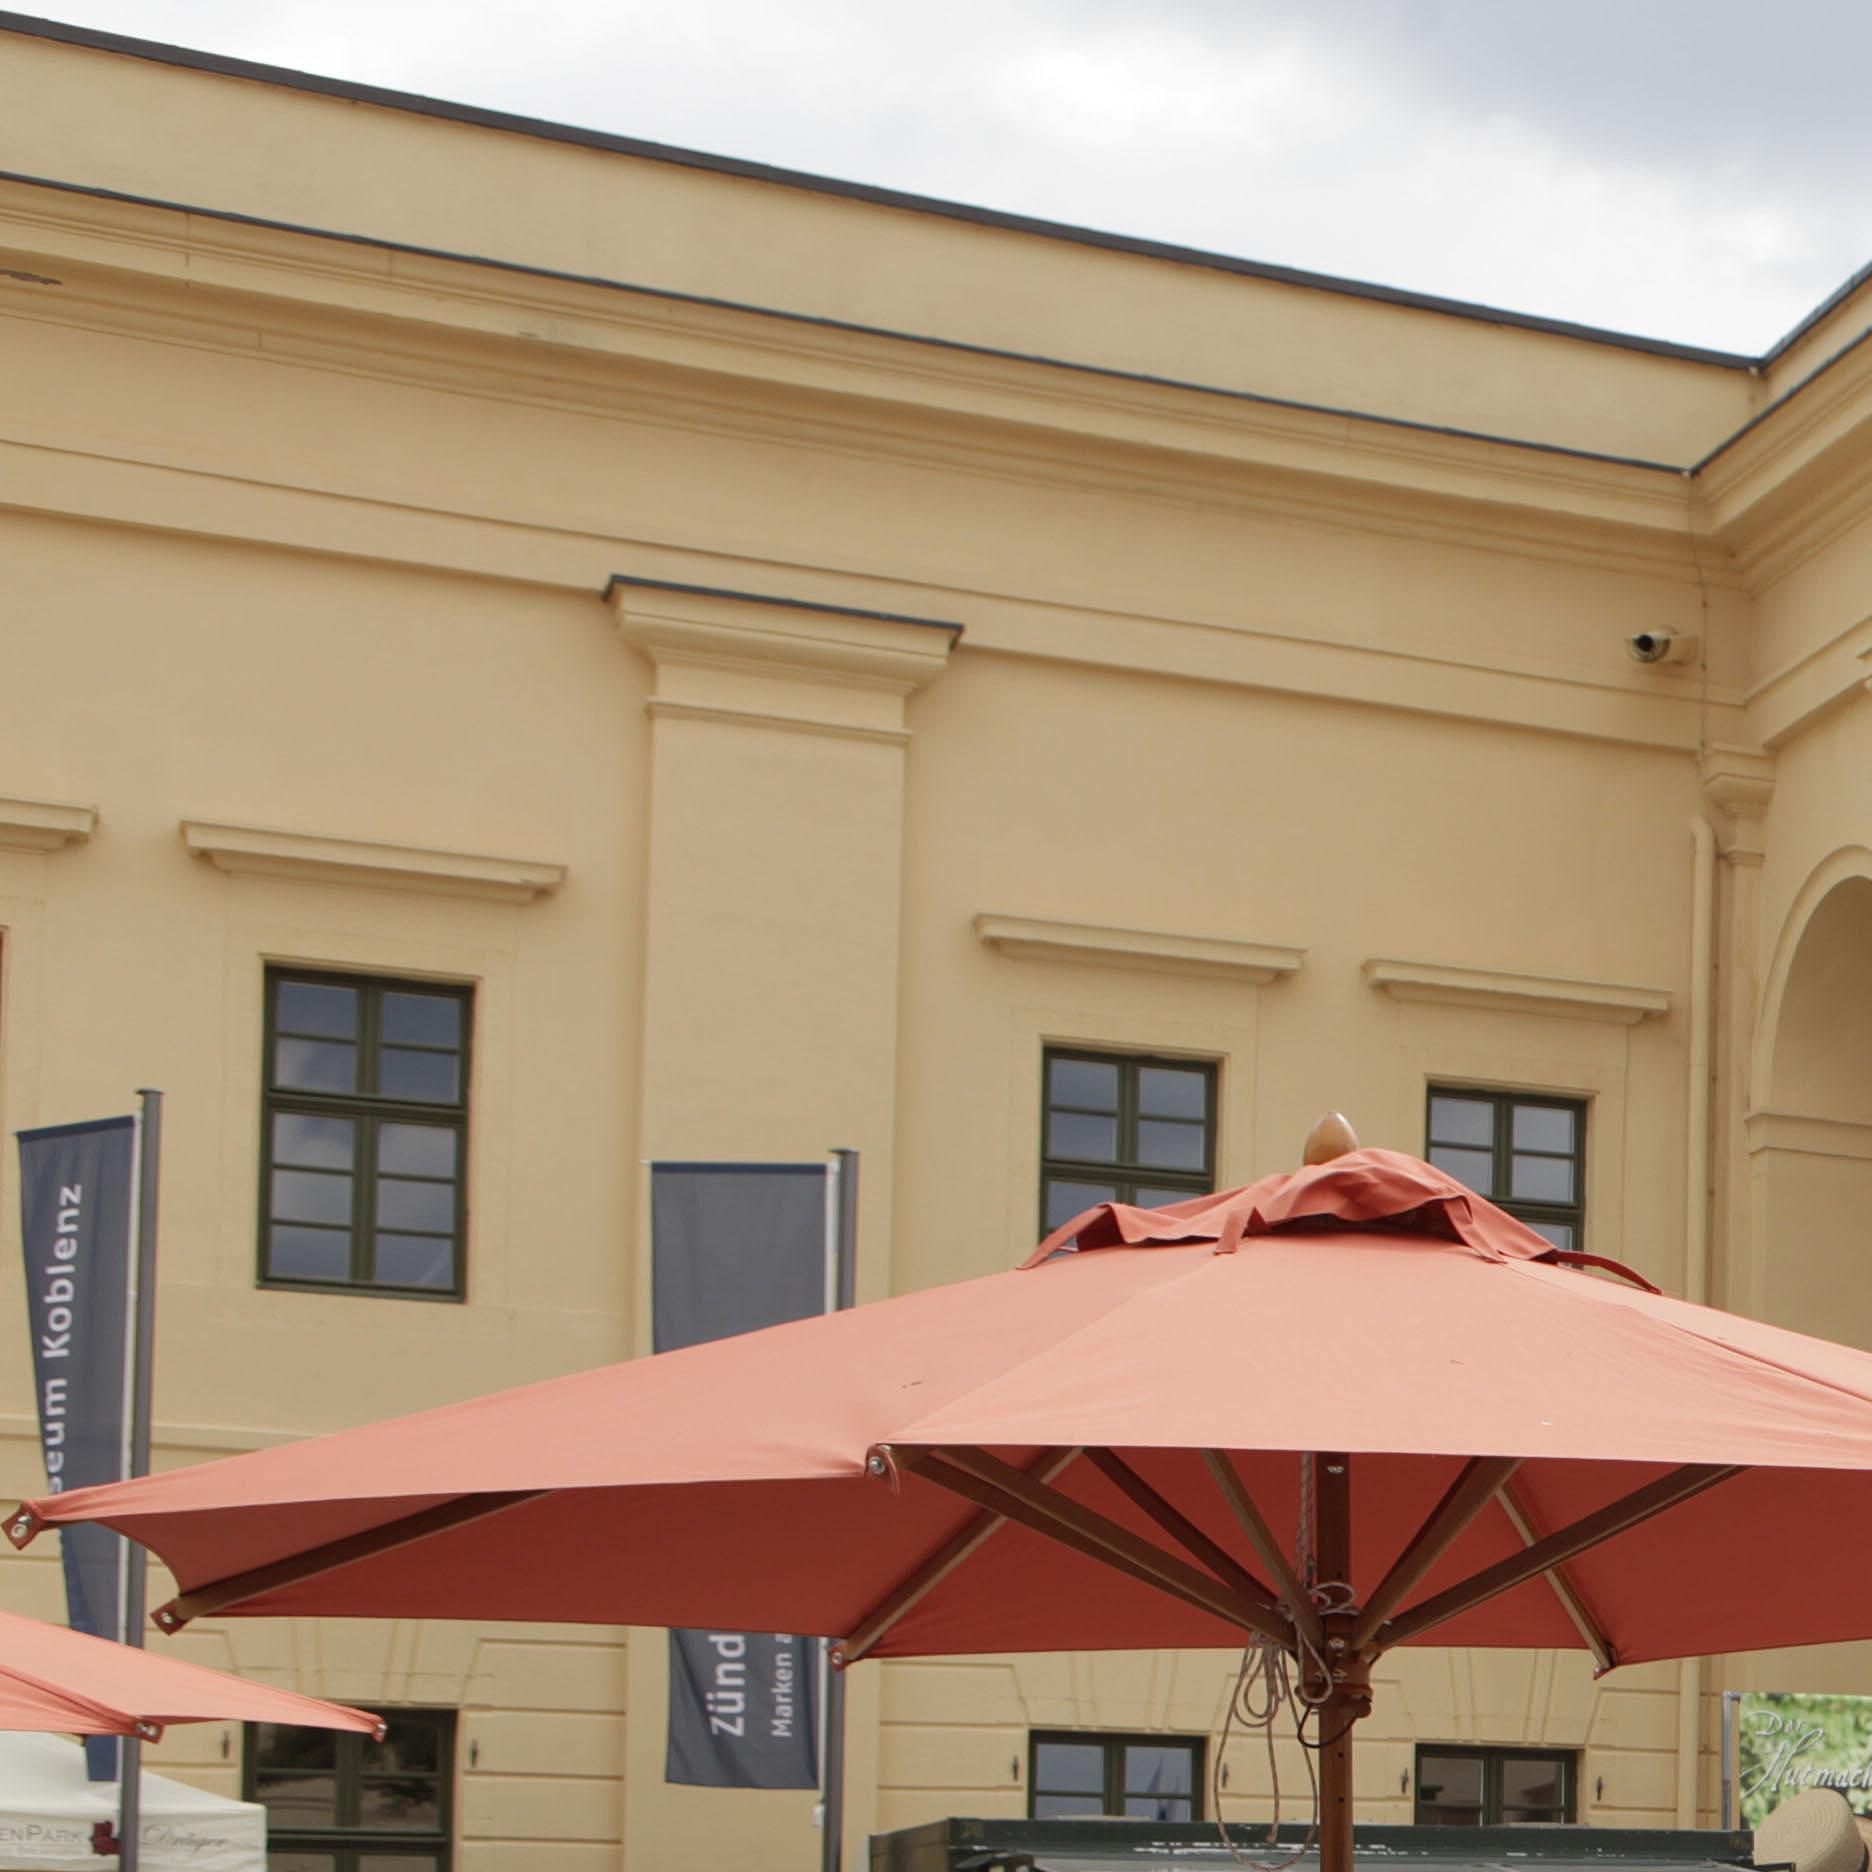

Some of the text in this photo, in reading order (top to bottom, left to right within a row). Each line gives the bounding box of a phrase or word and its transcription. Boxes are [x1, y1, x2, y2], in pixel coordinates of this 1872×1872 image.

[43, 1183, 82, 1359] Koblenz
[706, 1634, 746, 1737] Zünd
[771, 1652, 793, 1738] Marken
